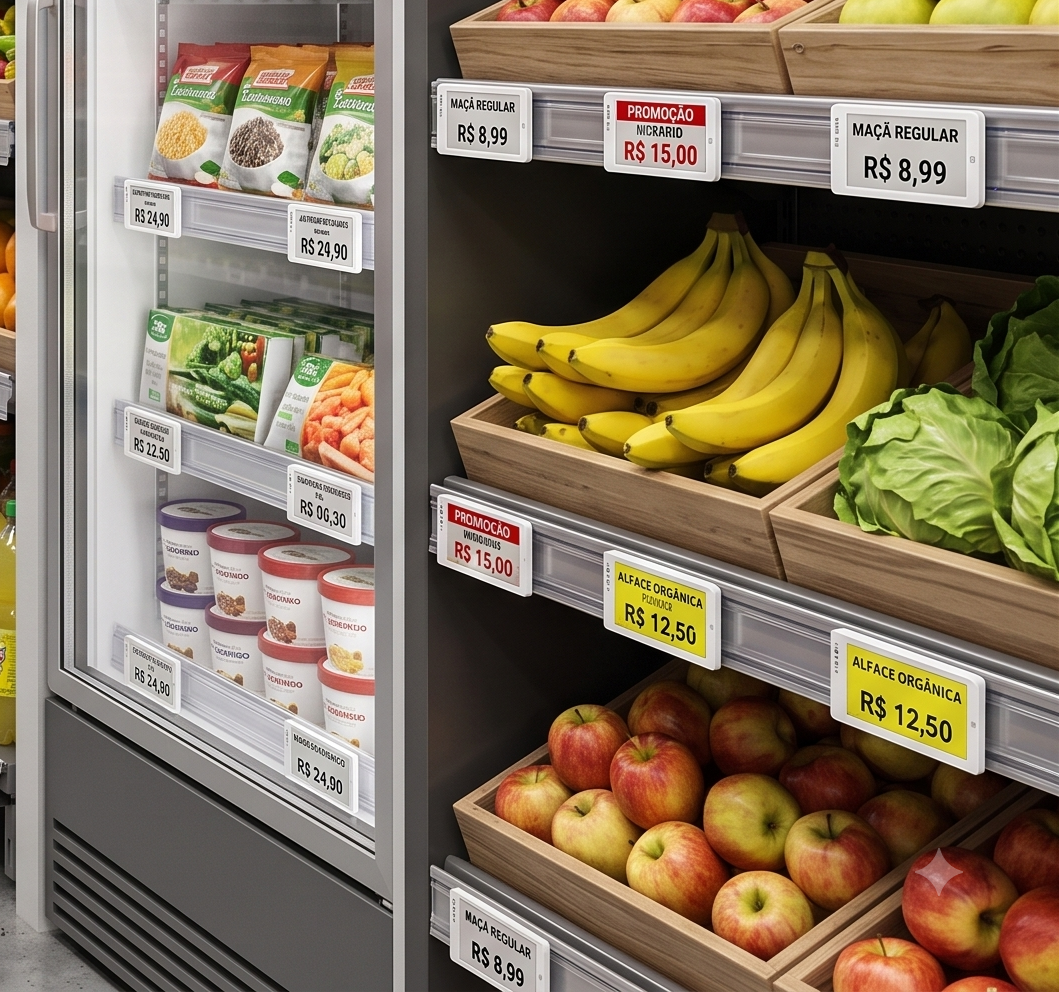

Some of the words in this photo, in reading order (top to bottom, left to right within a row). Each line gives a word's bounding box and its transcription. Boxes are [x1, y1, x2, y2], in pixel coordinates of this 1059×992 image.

[476, 100, 515, 113] REGULAR
[627, 104, 694, 124] PROMOÇÃO
[458, 122, 475, 146] R$
[478, 125, 508, 148] 8,99
[852, 121, 892, 141] MAÇÃ
[894, 125, 959, 144] REGULAR
[624, 139, 645, 164] R$
[651, 142, 698, 168] 15,00
[864, 153, 892, 183] R$
[898, 158, 947, 188] 8,99
[147, 210, 170, 228] 24,90
[317, 240, 348, 262] 24,90
[476, 549, 512, 577] 15,00
[618, 572, 652, 592] ALFACE
[653, 582, 703, 610] ORGÂNICA
[625, 602, 645, 629] R$
[651, 613, 696, 646] 12,50
[852, 655, 895, 681] ALFACE
[898, 671, 962, 705] ORGÂNICA
[860, 689, 887, 722] R$
[894, 703, 952, 744] 12,50
[313, 766, 343, 795] 24,90
[490, 925, 531, 960] REGULAR
[493, 954, 524, 987] 8,99
